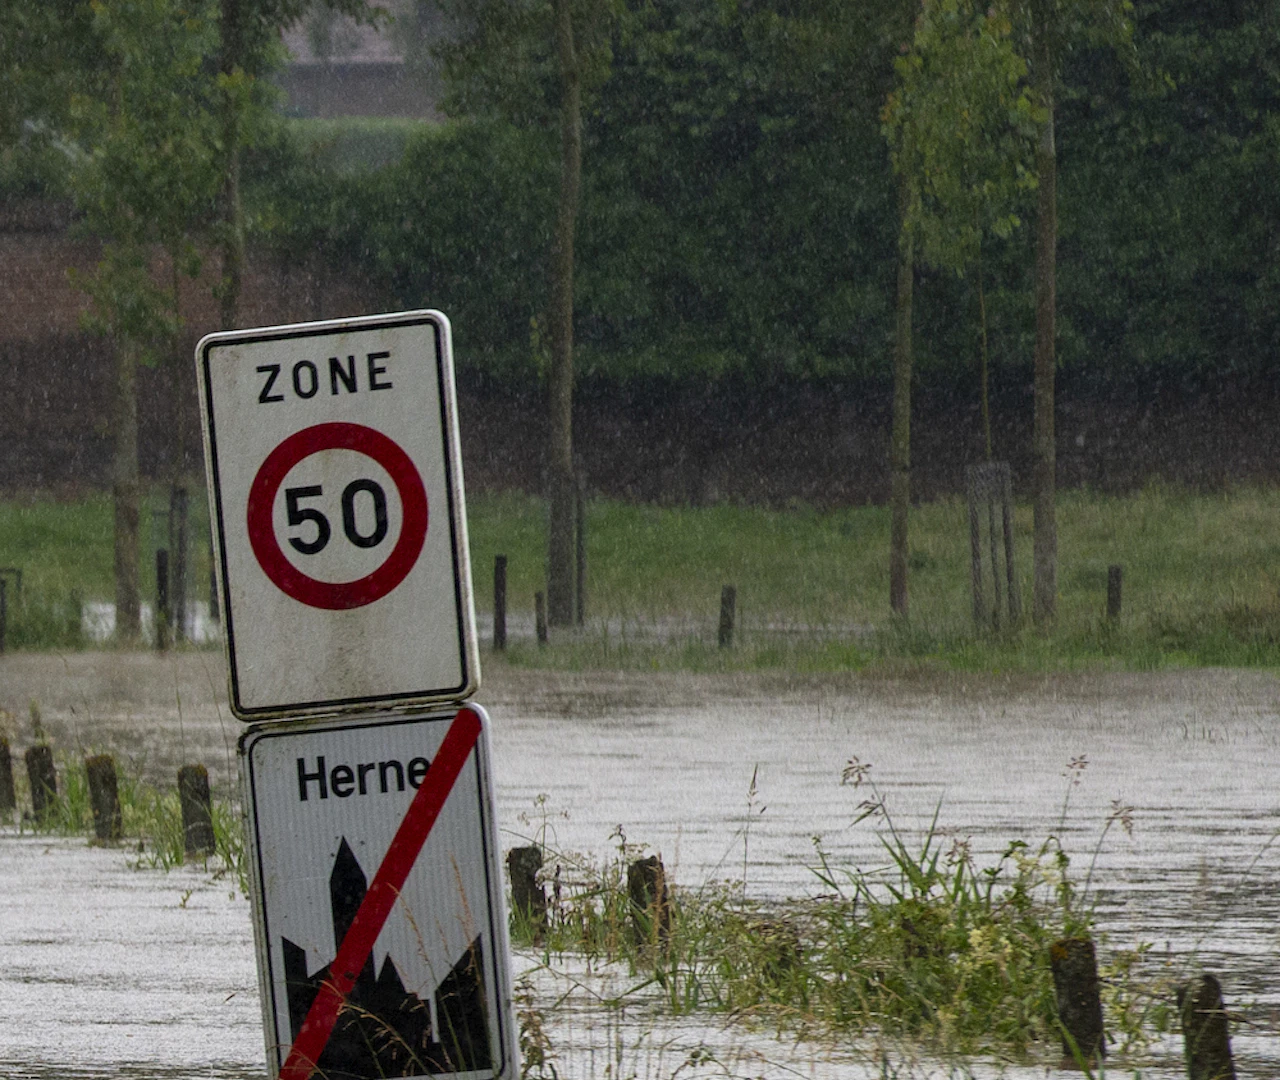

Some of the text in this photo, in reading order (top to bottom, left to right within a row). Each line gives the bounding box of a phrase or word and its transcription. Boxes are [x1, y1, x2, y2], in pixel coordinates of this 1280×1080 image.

[256, 351, 393, 404] ZONE
[285, 478, 389, 555] 50
[297, 756, 432, 801] Herne
